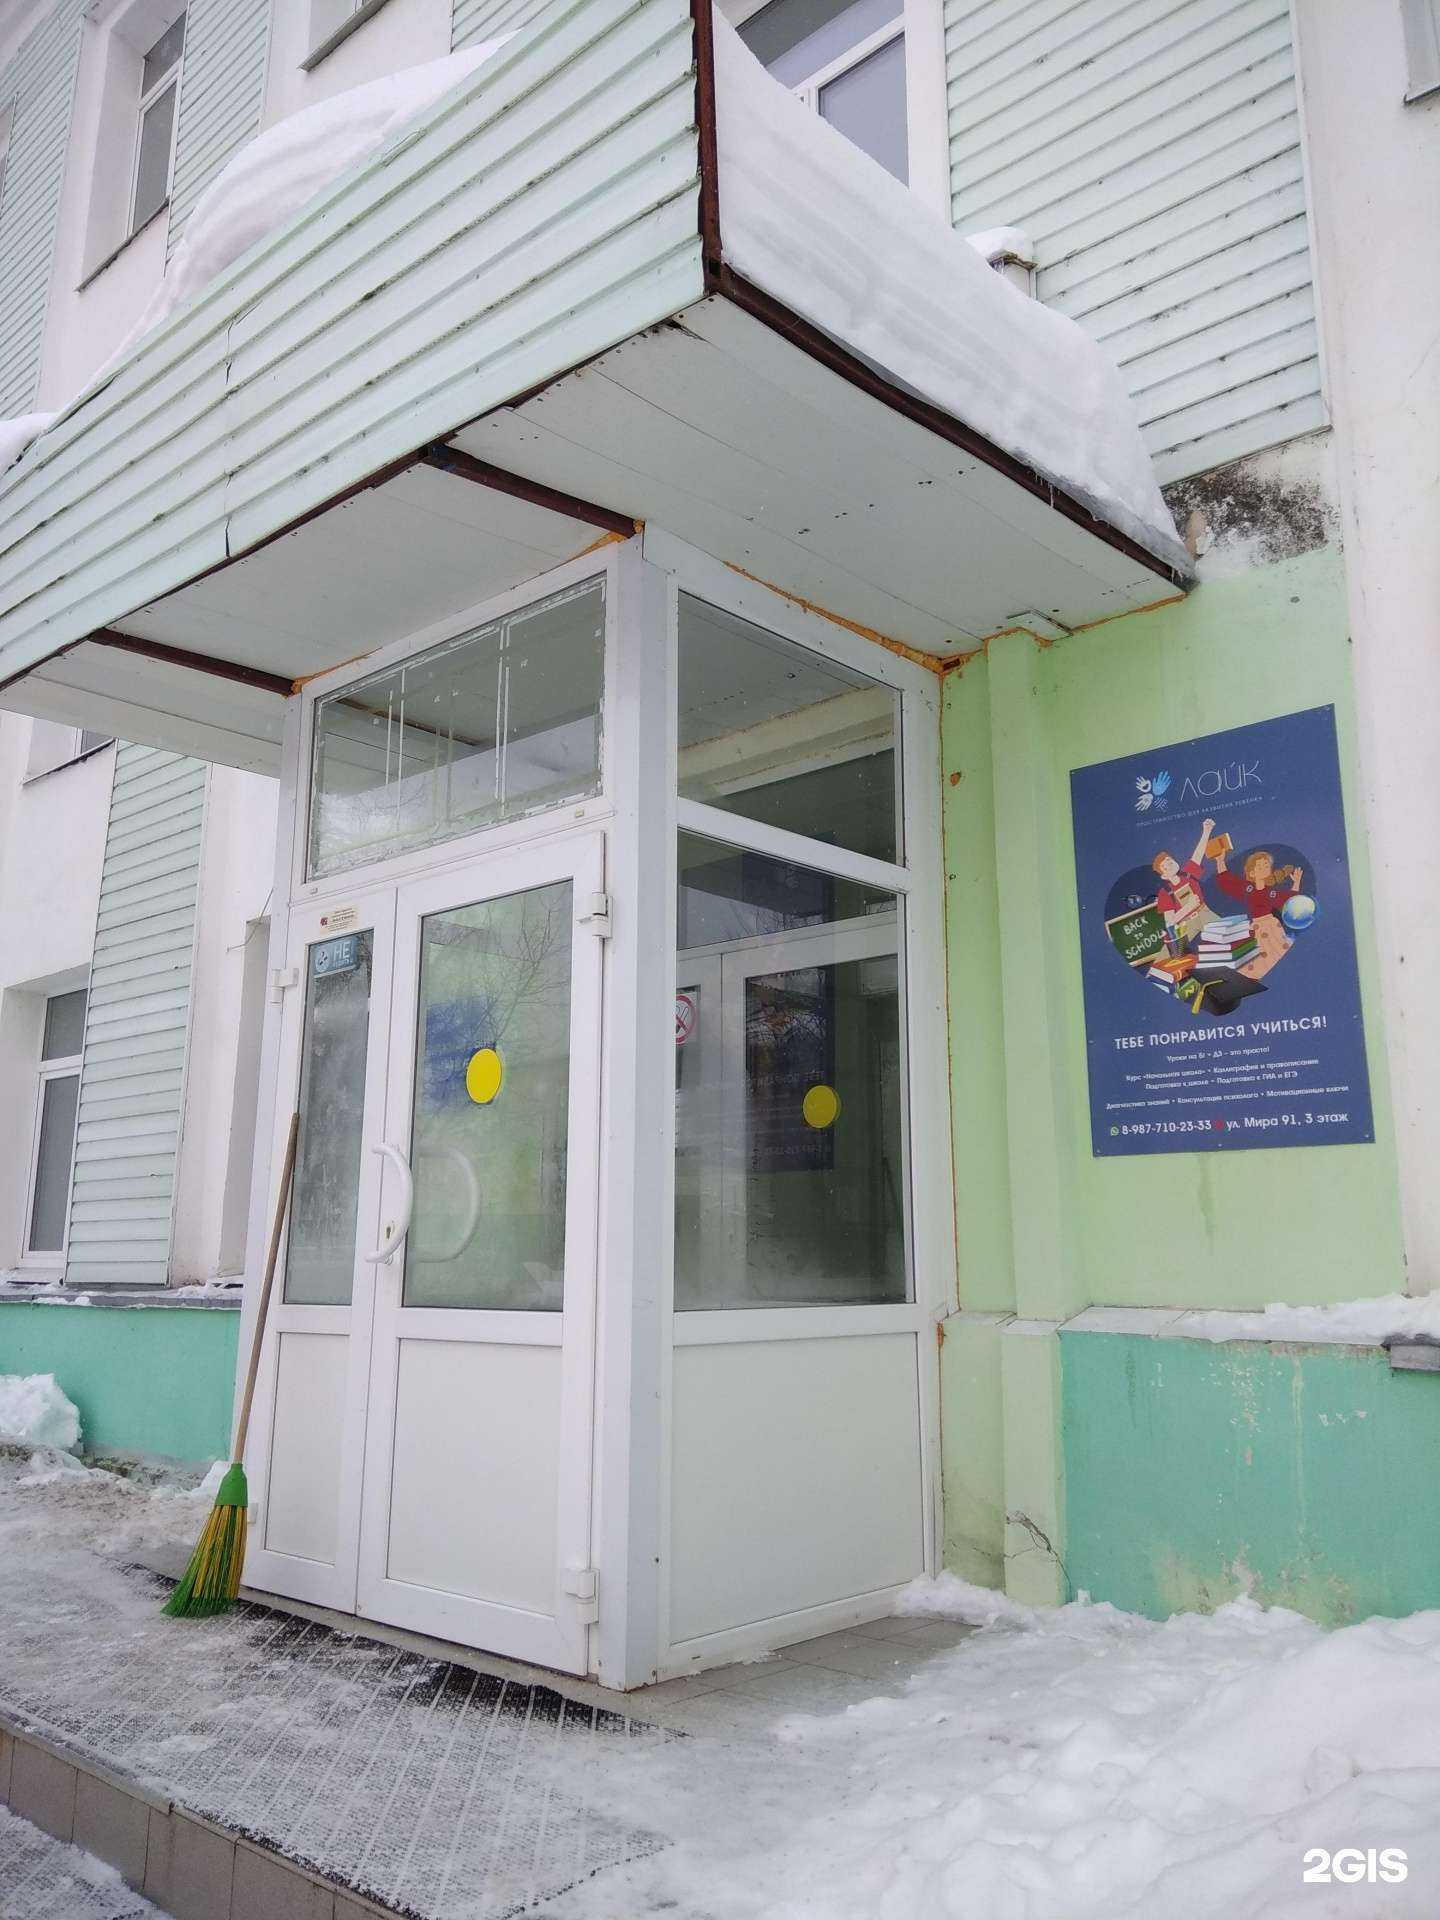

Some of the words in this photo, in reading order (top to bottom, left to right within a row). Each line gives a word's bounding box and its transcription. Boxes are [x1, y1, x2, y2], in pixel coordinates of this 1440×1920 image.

[1123, 916, 1149, 936] BACK
[1126, 930, 1164, 959] SCHOOL
[1114, 1036, 1145, 1050] ТЕБЕ
[1149, 1025, 1245, 1046] ПОНРАВИТСЯ
[1251, 1015, 1327, 1036] УЧИТЬСЯ!
[1242, 1046, 1270, 1055] просто!
[1284, 1070, 1298, 1079] ЕГЭ
[1121, 1120, 1212, 1135] 8-987-710-23-33
[1226, 1121, 1241, 1131] ул.
[1244, 1117, 1279, 1129] Мира
[1281, 1114, 1302, 1126] 91,
[1304, 1113, 1314, 1124] 3
[1316, 1113, 1349, 1123] этаж
